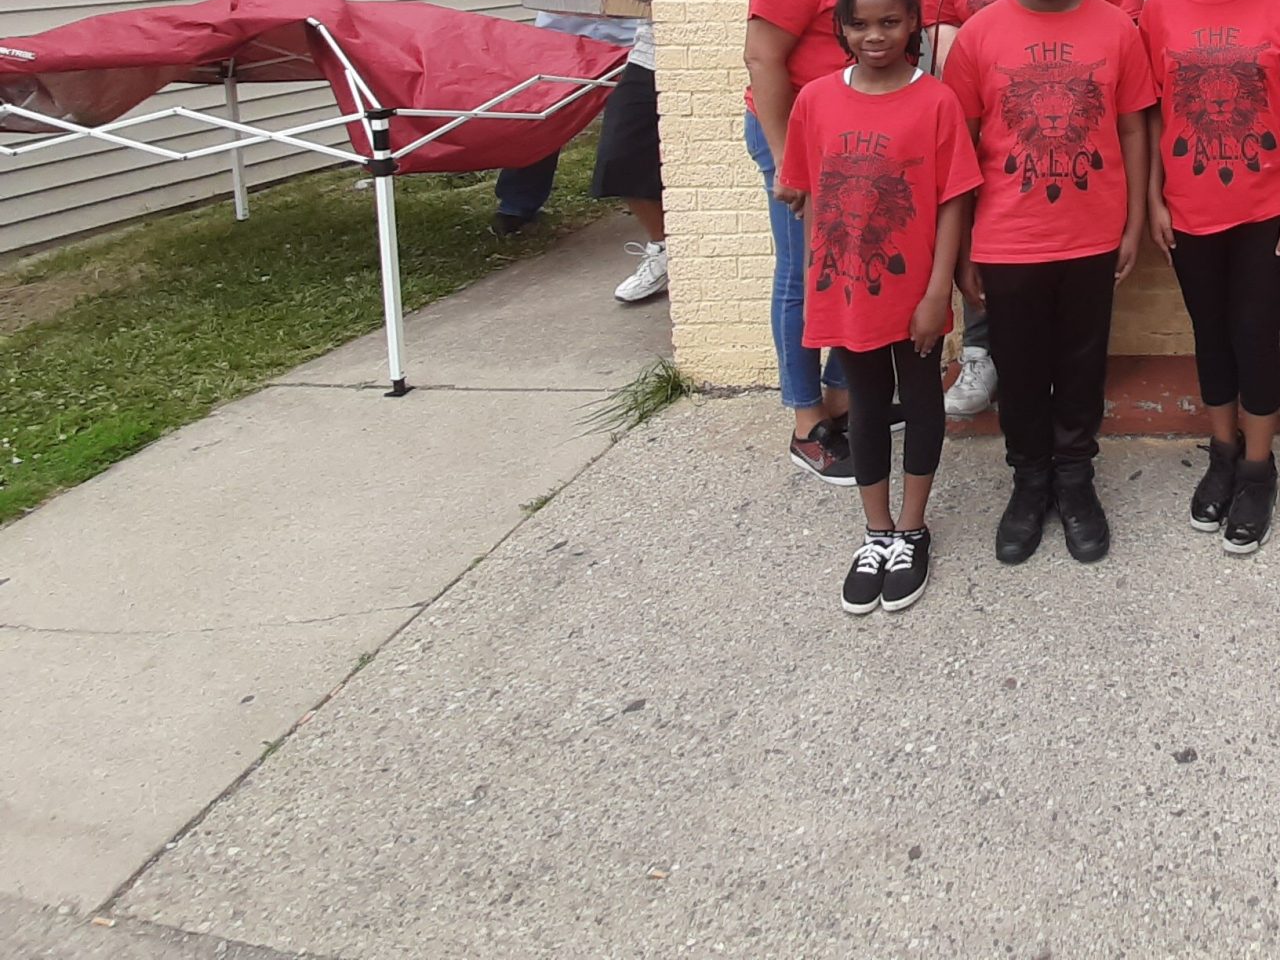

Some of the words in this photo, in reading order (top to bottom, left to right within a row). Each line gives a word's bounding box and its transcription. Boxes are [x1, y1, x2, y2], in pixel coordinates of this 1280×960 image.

[1191, 27, 1241, 48] THE
[1025, 41, 1074, 63] THE
[837, 130, 891, 158] THE
